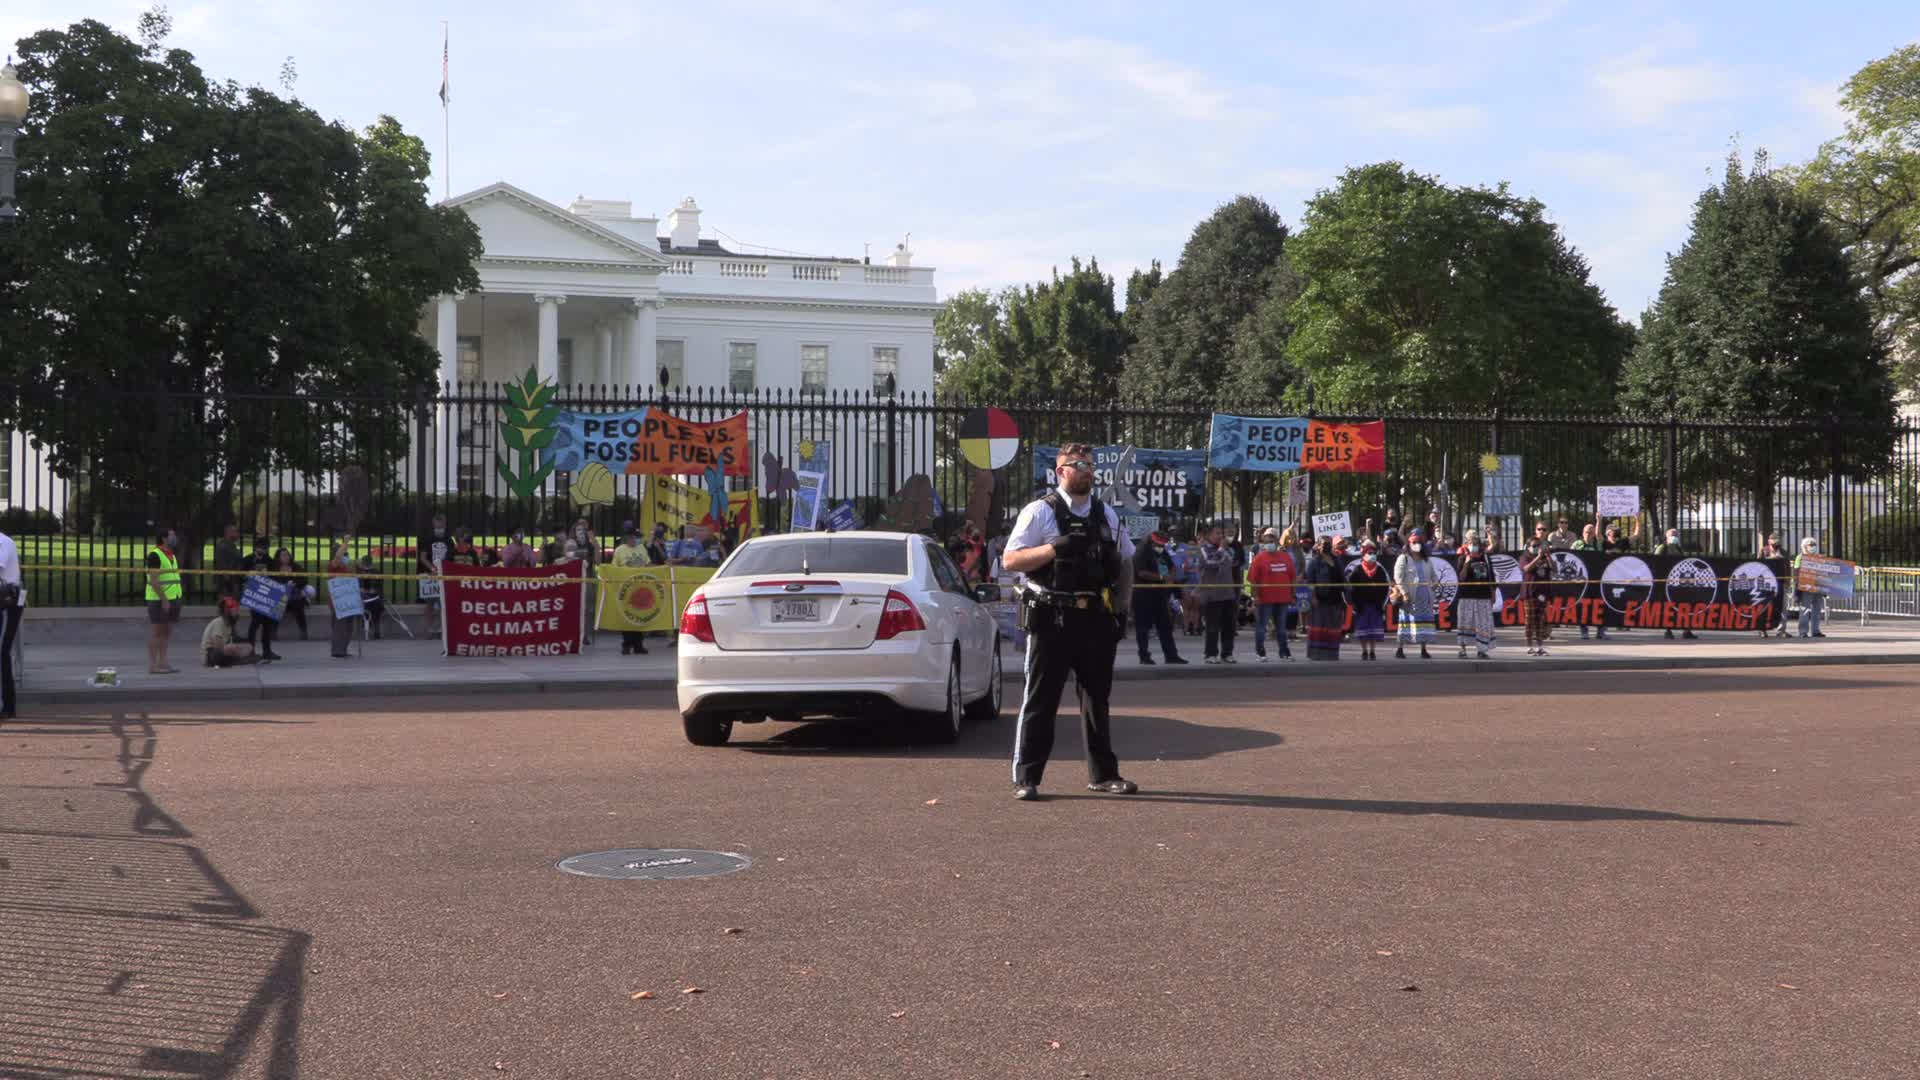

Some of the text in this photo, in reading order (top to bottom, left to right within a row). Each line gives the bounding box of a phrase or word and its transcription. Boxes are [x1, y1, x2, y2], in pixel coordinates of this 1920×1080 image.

[583, 418, 694, 441] PEOPLE
[1247, 425, 1325, 444] PEOPLE
[583, 441, 735, 465] FOSSIL FUELS
[1246, 444, 1353, 463] FOSSIL FUELS
[1093, 468, 1187, 486] SOUTIONS
[1318, 513, 1343, 524] STOP
[1318, 522, 1346, 533] LINE 3
[460, 573, 569, 591] RICHMOND
[461, 598, 566, 615] DECLARES
[1501, 596, 1774, 630] CLMATE EMERGENCY!
[469, 617, 560, 636] CLIMATE
[456, 640, 573, 657] EMERGENCY
